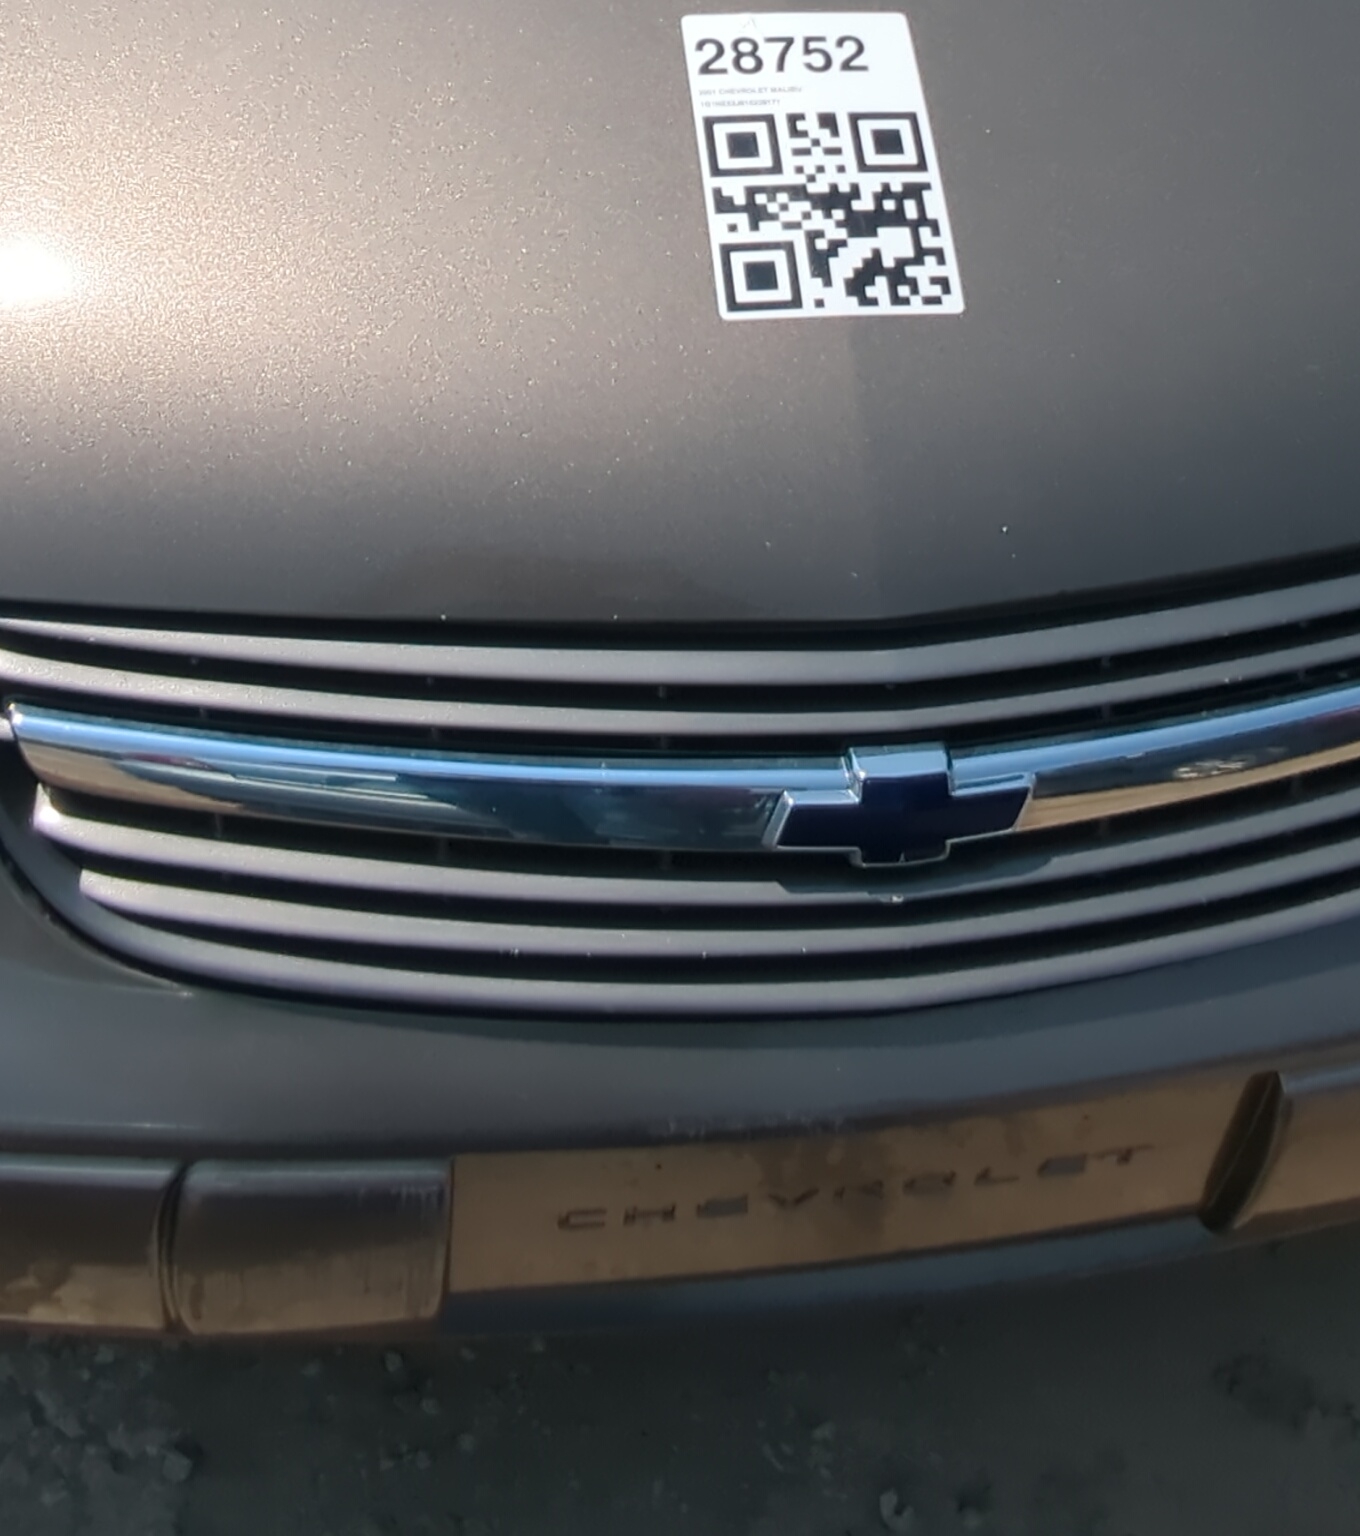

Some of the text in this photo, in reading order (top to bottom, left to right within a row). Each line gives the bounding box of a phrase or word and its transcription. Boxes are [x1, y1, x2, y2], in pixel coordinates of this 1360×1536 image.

[694, 35, 870, 76] 28752
[719, 87, 768, 95] CHEVROLET
[557, 1144, 1154, 1232] CHEVROLET
